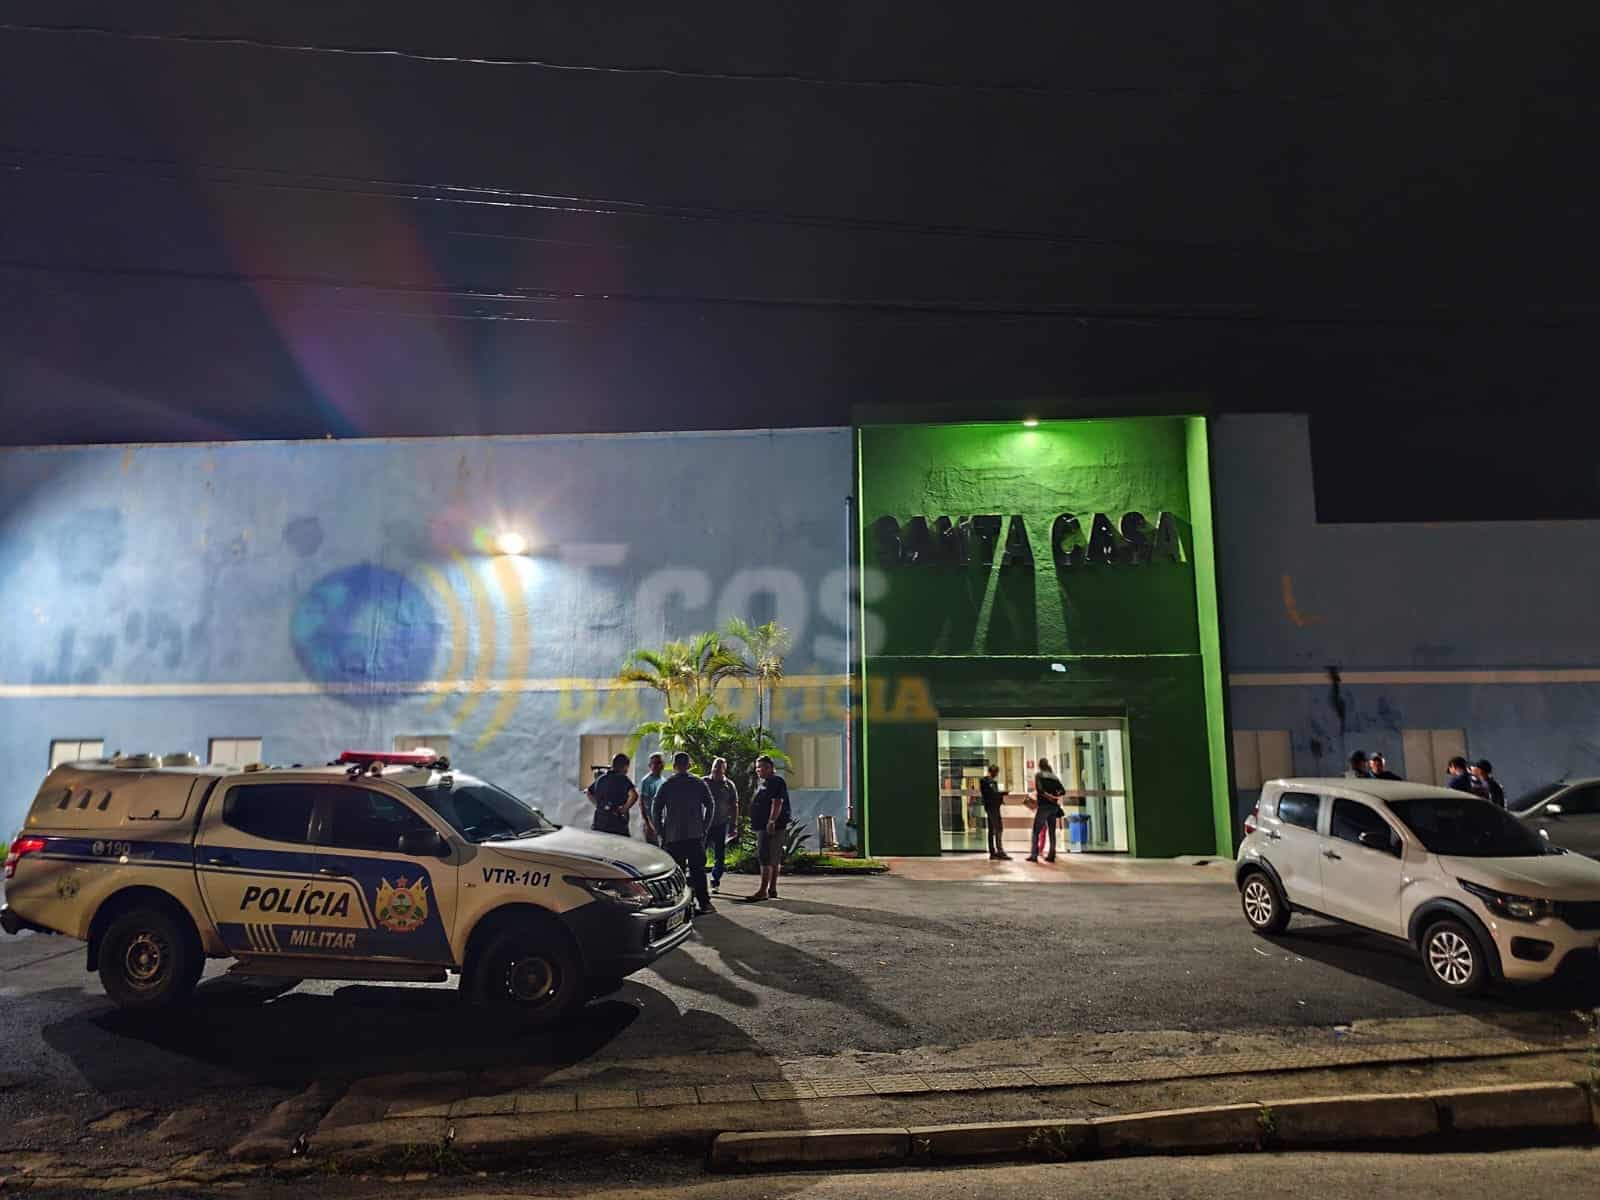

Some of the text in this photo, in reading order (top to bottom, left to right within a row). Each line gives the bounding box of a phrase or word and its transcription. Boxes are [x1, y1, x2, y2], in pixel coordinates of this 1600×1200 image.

[873, 511, 1188, 566] SANTA CASA
[482, 867, 551, 887] VTR-101
[240, 882, 350, 917] POLÍCIA
[290, 929, 356, 949] MILITAR
